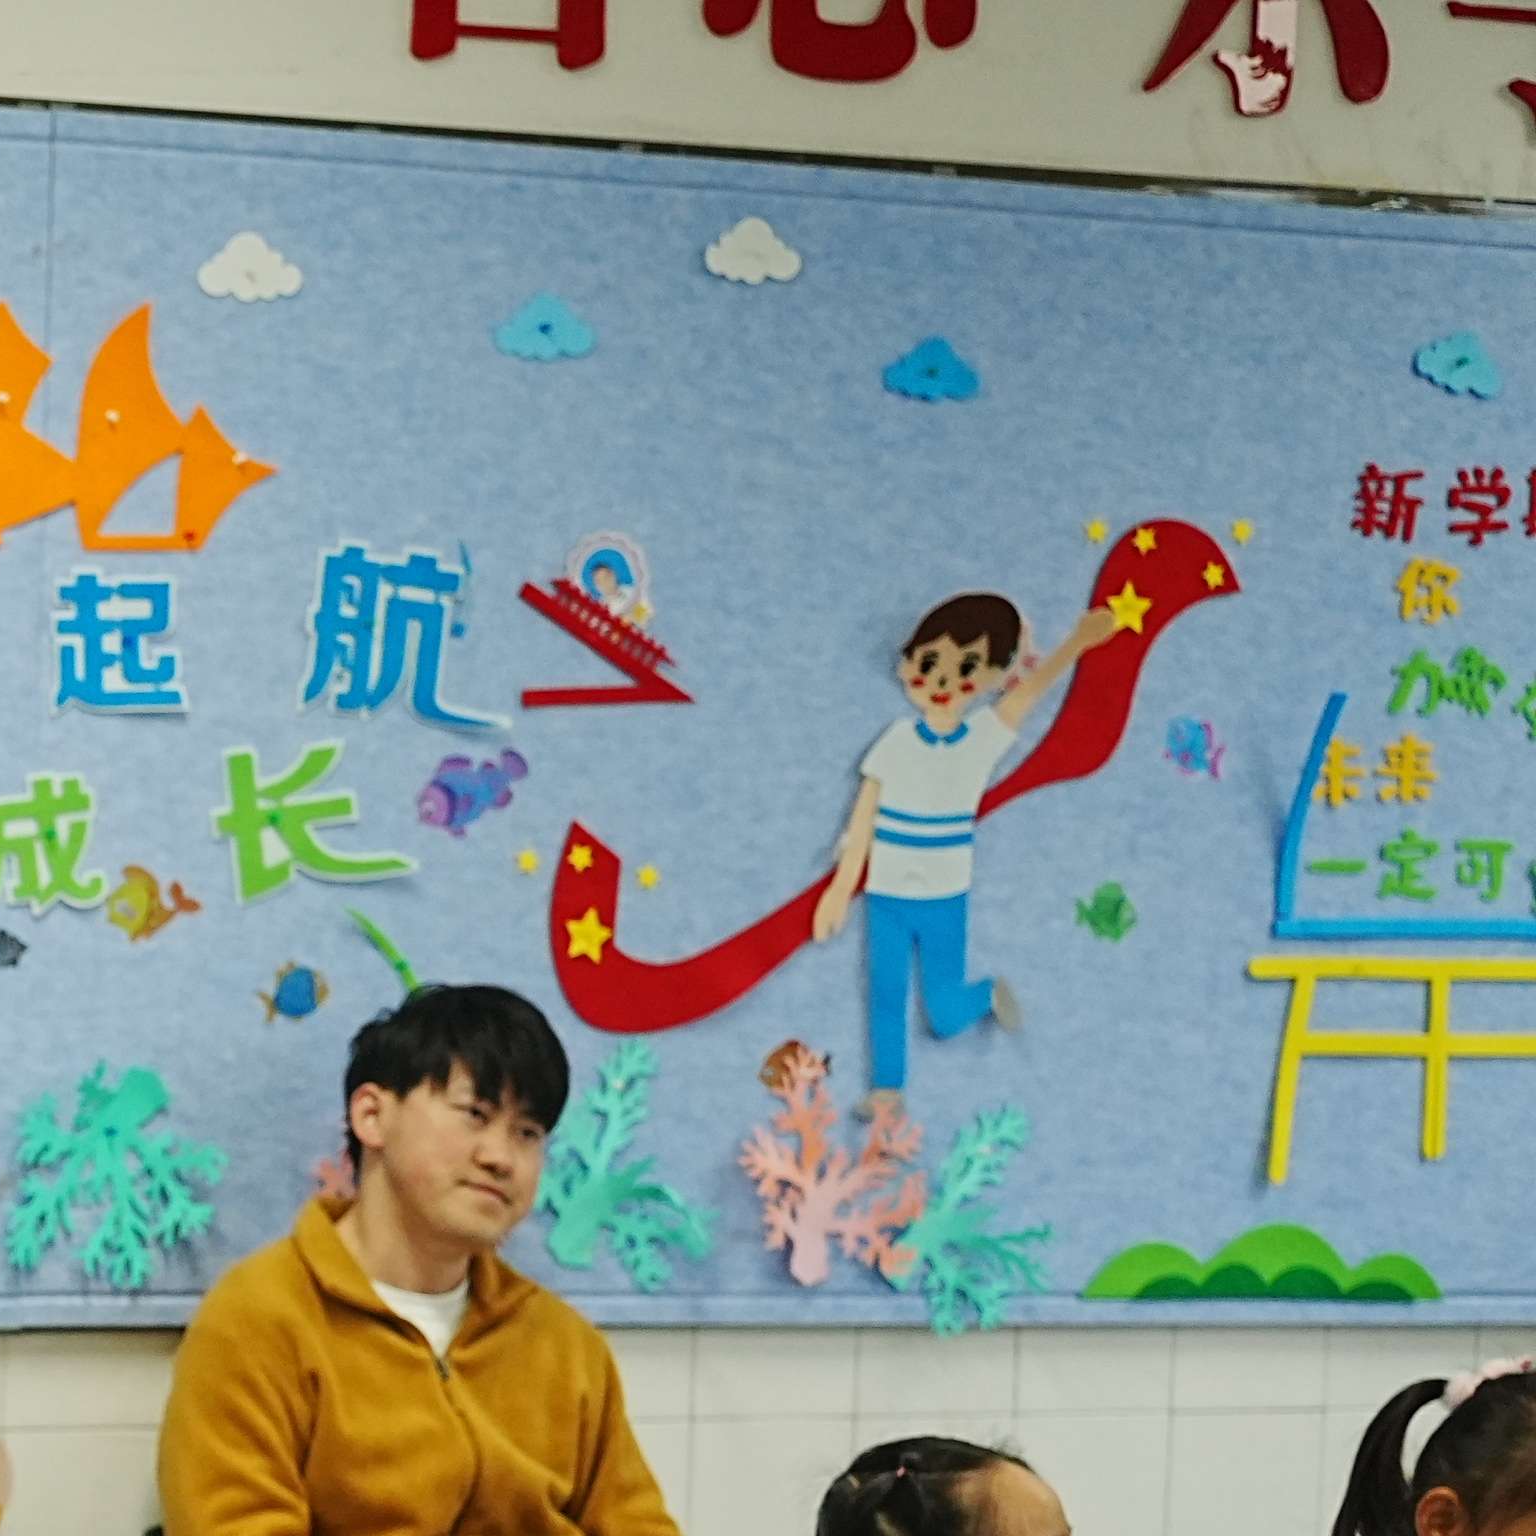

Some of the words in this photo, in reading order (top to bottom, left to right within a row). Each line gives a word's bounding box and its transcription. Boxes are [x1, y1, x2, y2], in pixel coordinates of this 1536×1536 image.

[1350, 463, 1536, 545] 新学
[1304, 827, 1536, 905] 一定可
